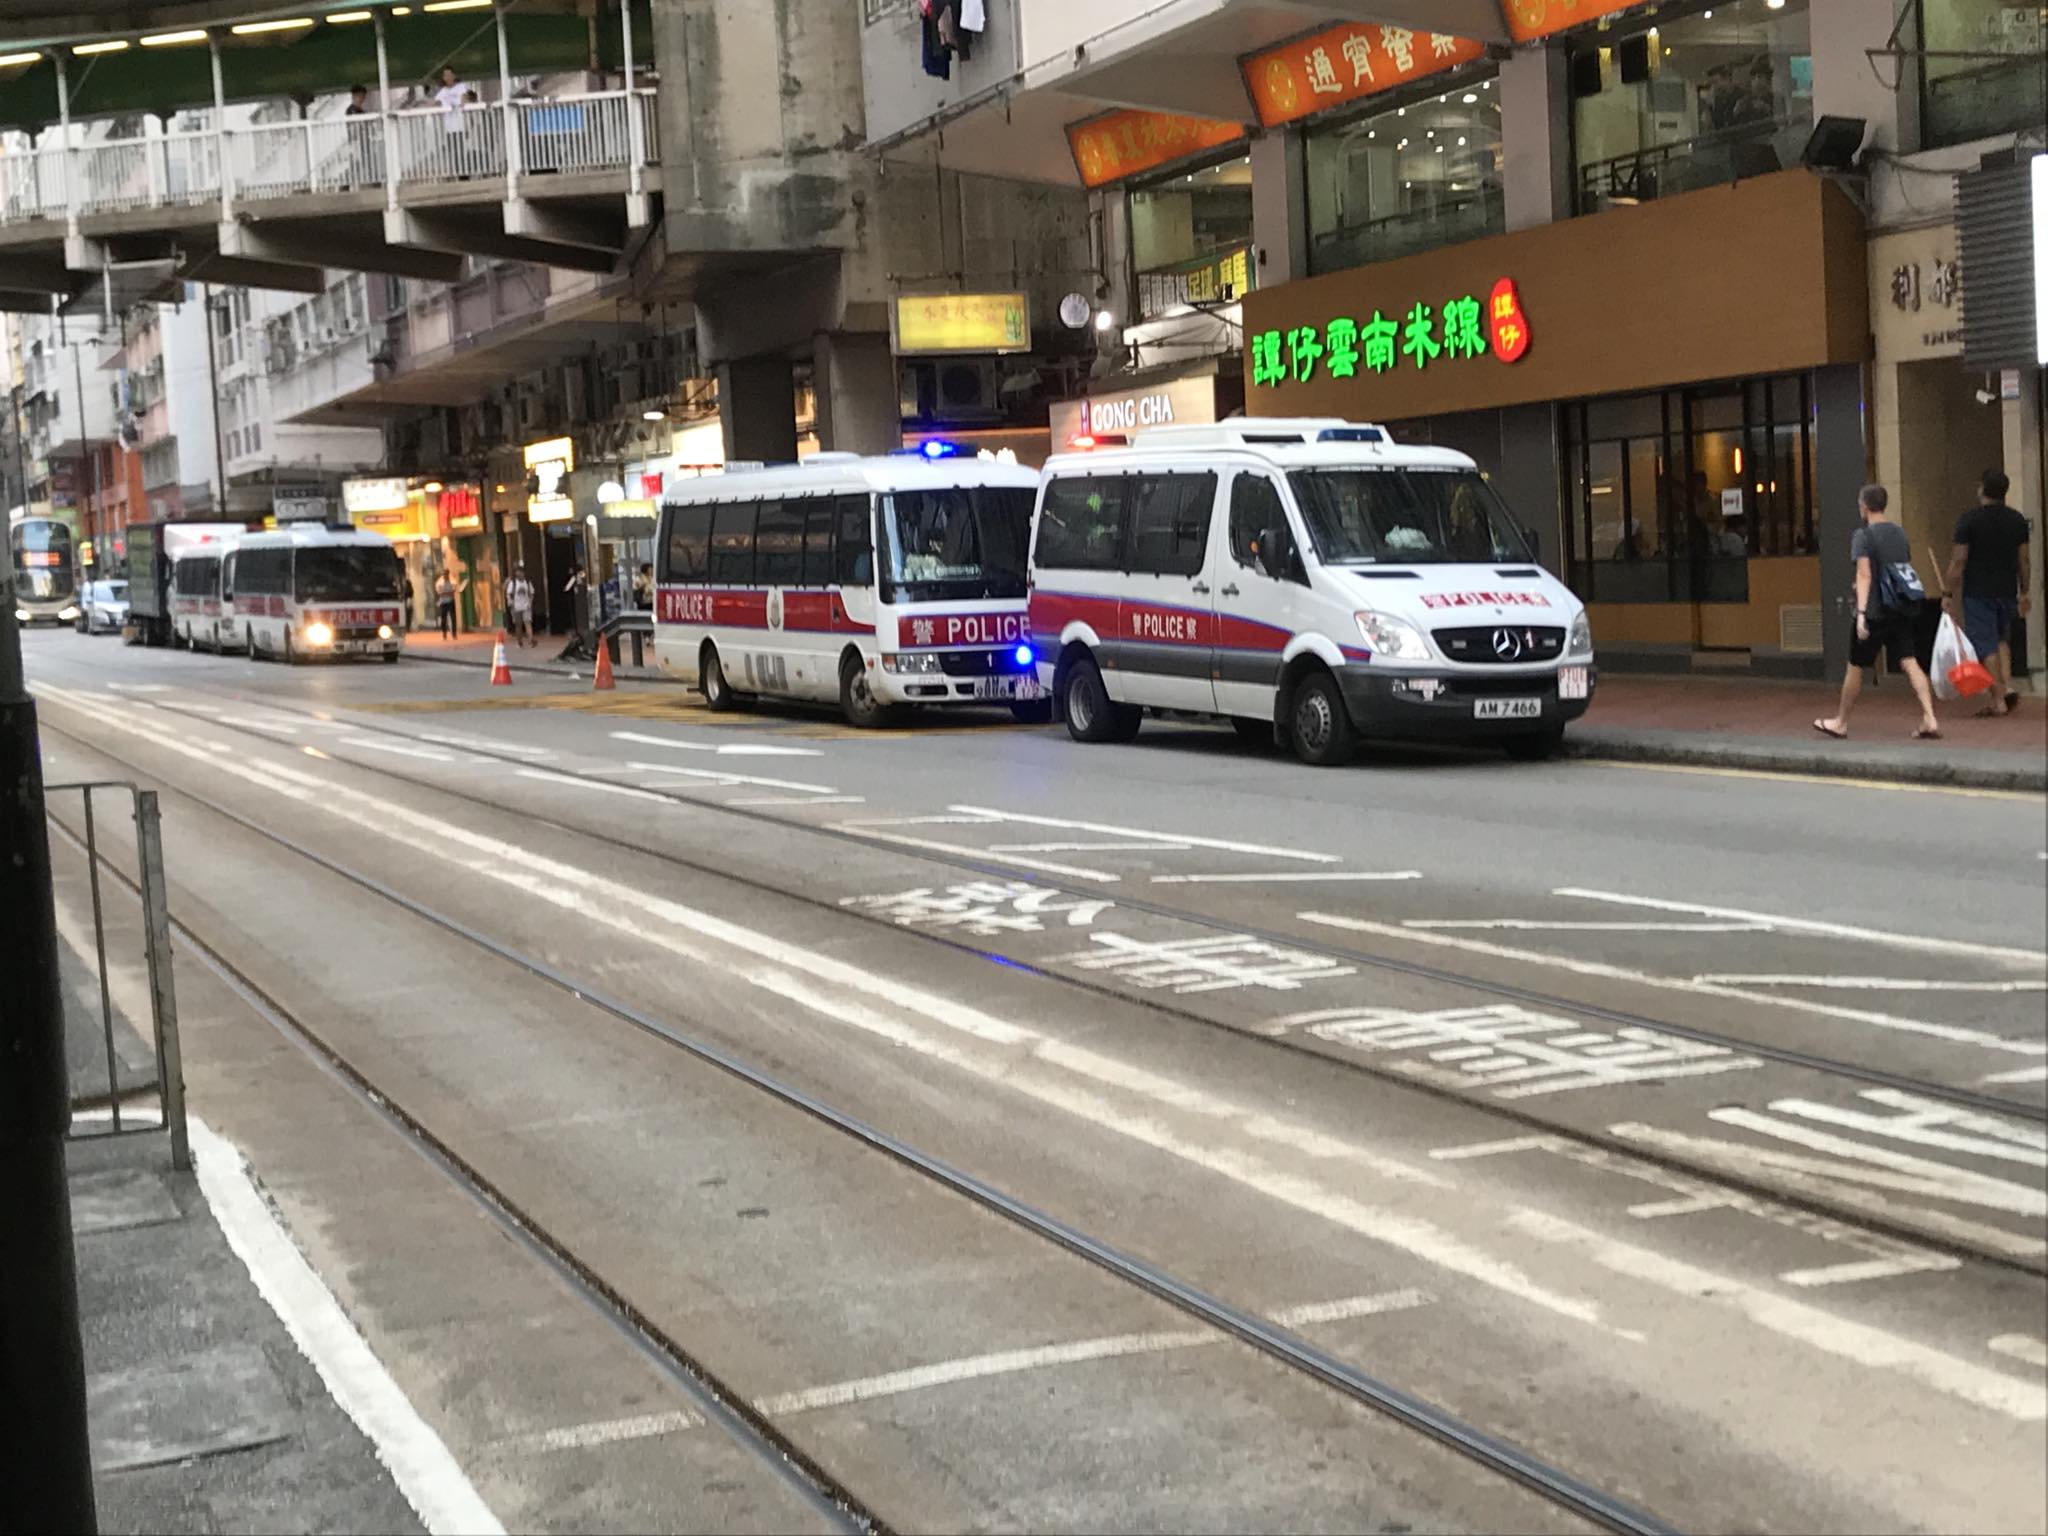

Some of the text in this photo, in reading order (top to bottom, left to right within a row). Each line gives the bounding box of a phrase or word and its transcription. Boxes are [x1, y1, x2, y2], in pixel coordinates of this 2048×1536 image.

[1495, 294, 1520, 350] 譚仔
[1252, 295, 1486, 388] 譚仔雲南米線
[1092, 393, 1174, 432] GONG CHA
[674, 593, 703, 620] POLICE
[1144, 612, 1184, 639] POLICE
[1479, 702, 1537, 716] AM 7466
